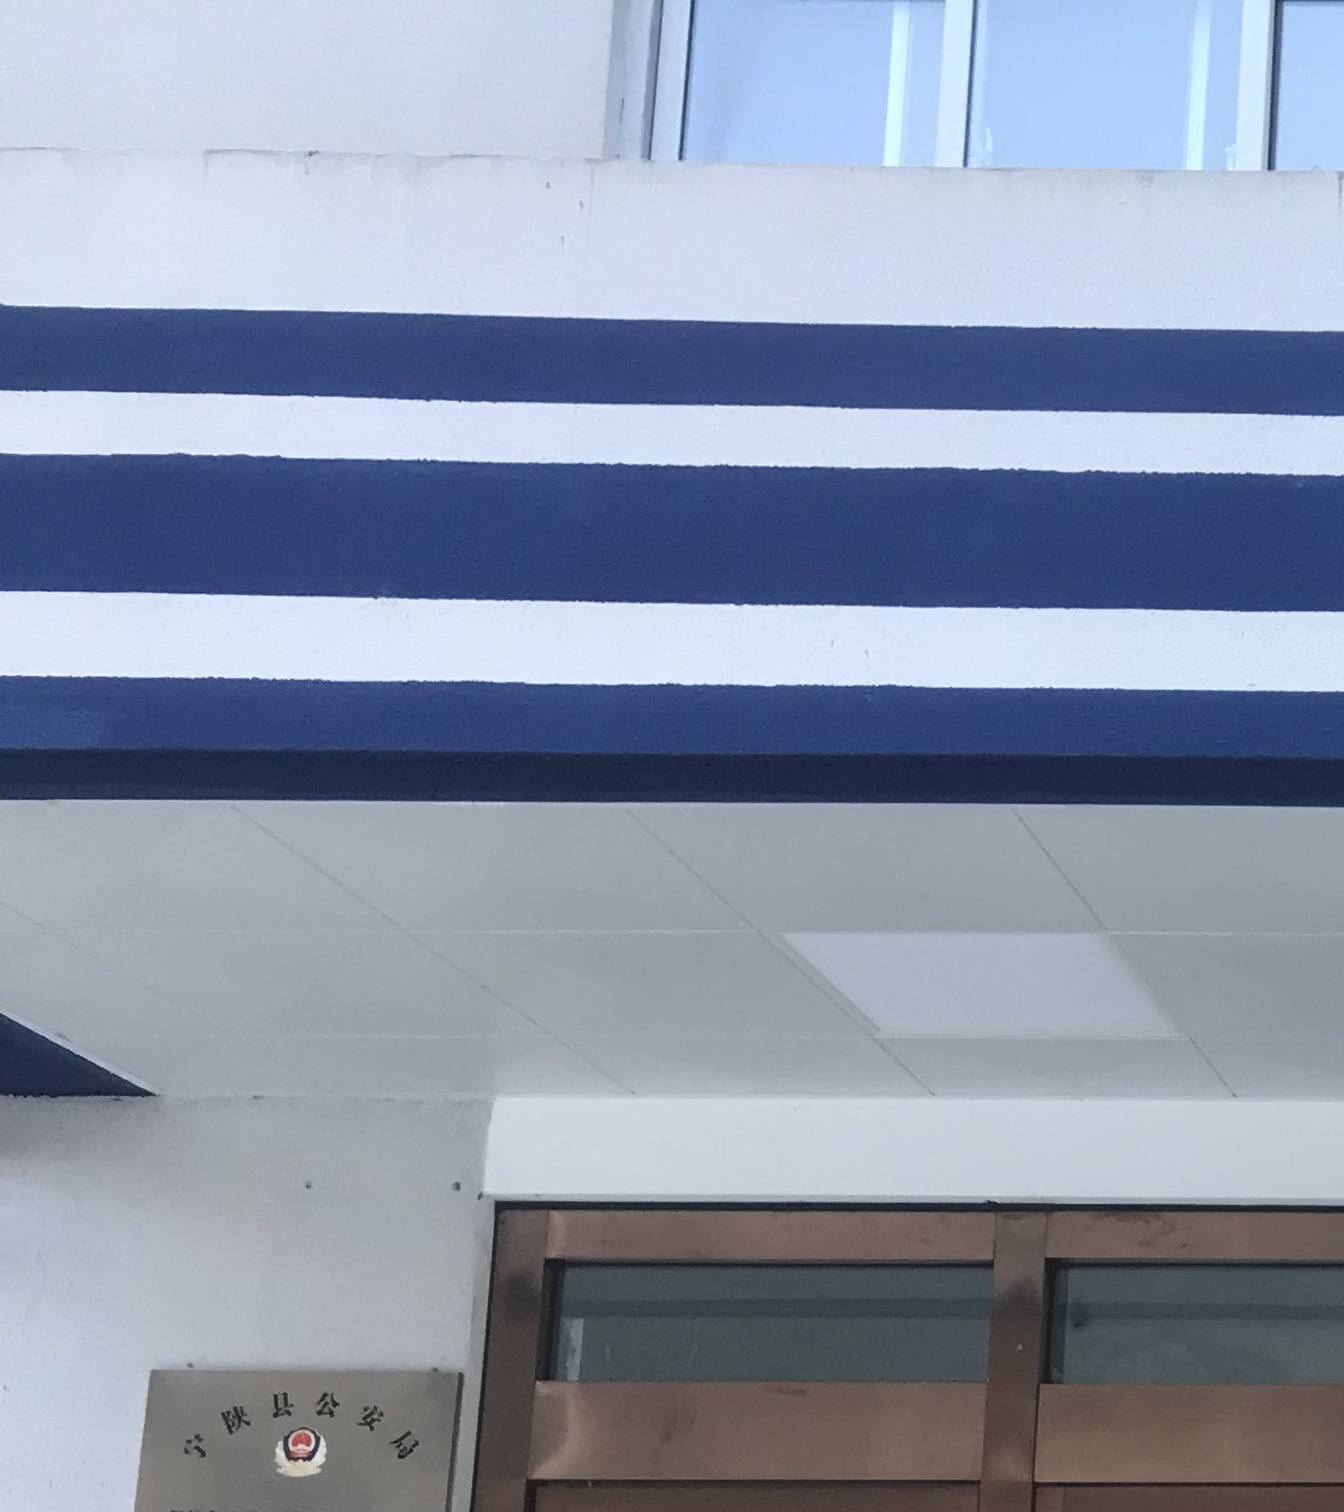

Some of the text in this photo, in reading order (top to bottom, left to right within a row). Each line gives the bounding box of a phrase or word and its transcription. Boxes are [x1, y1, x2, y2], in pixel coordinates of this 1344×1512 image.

[183, 1391, 420, 1460] 宁陕县公安局
